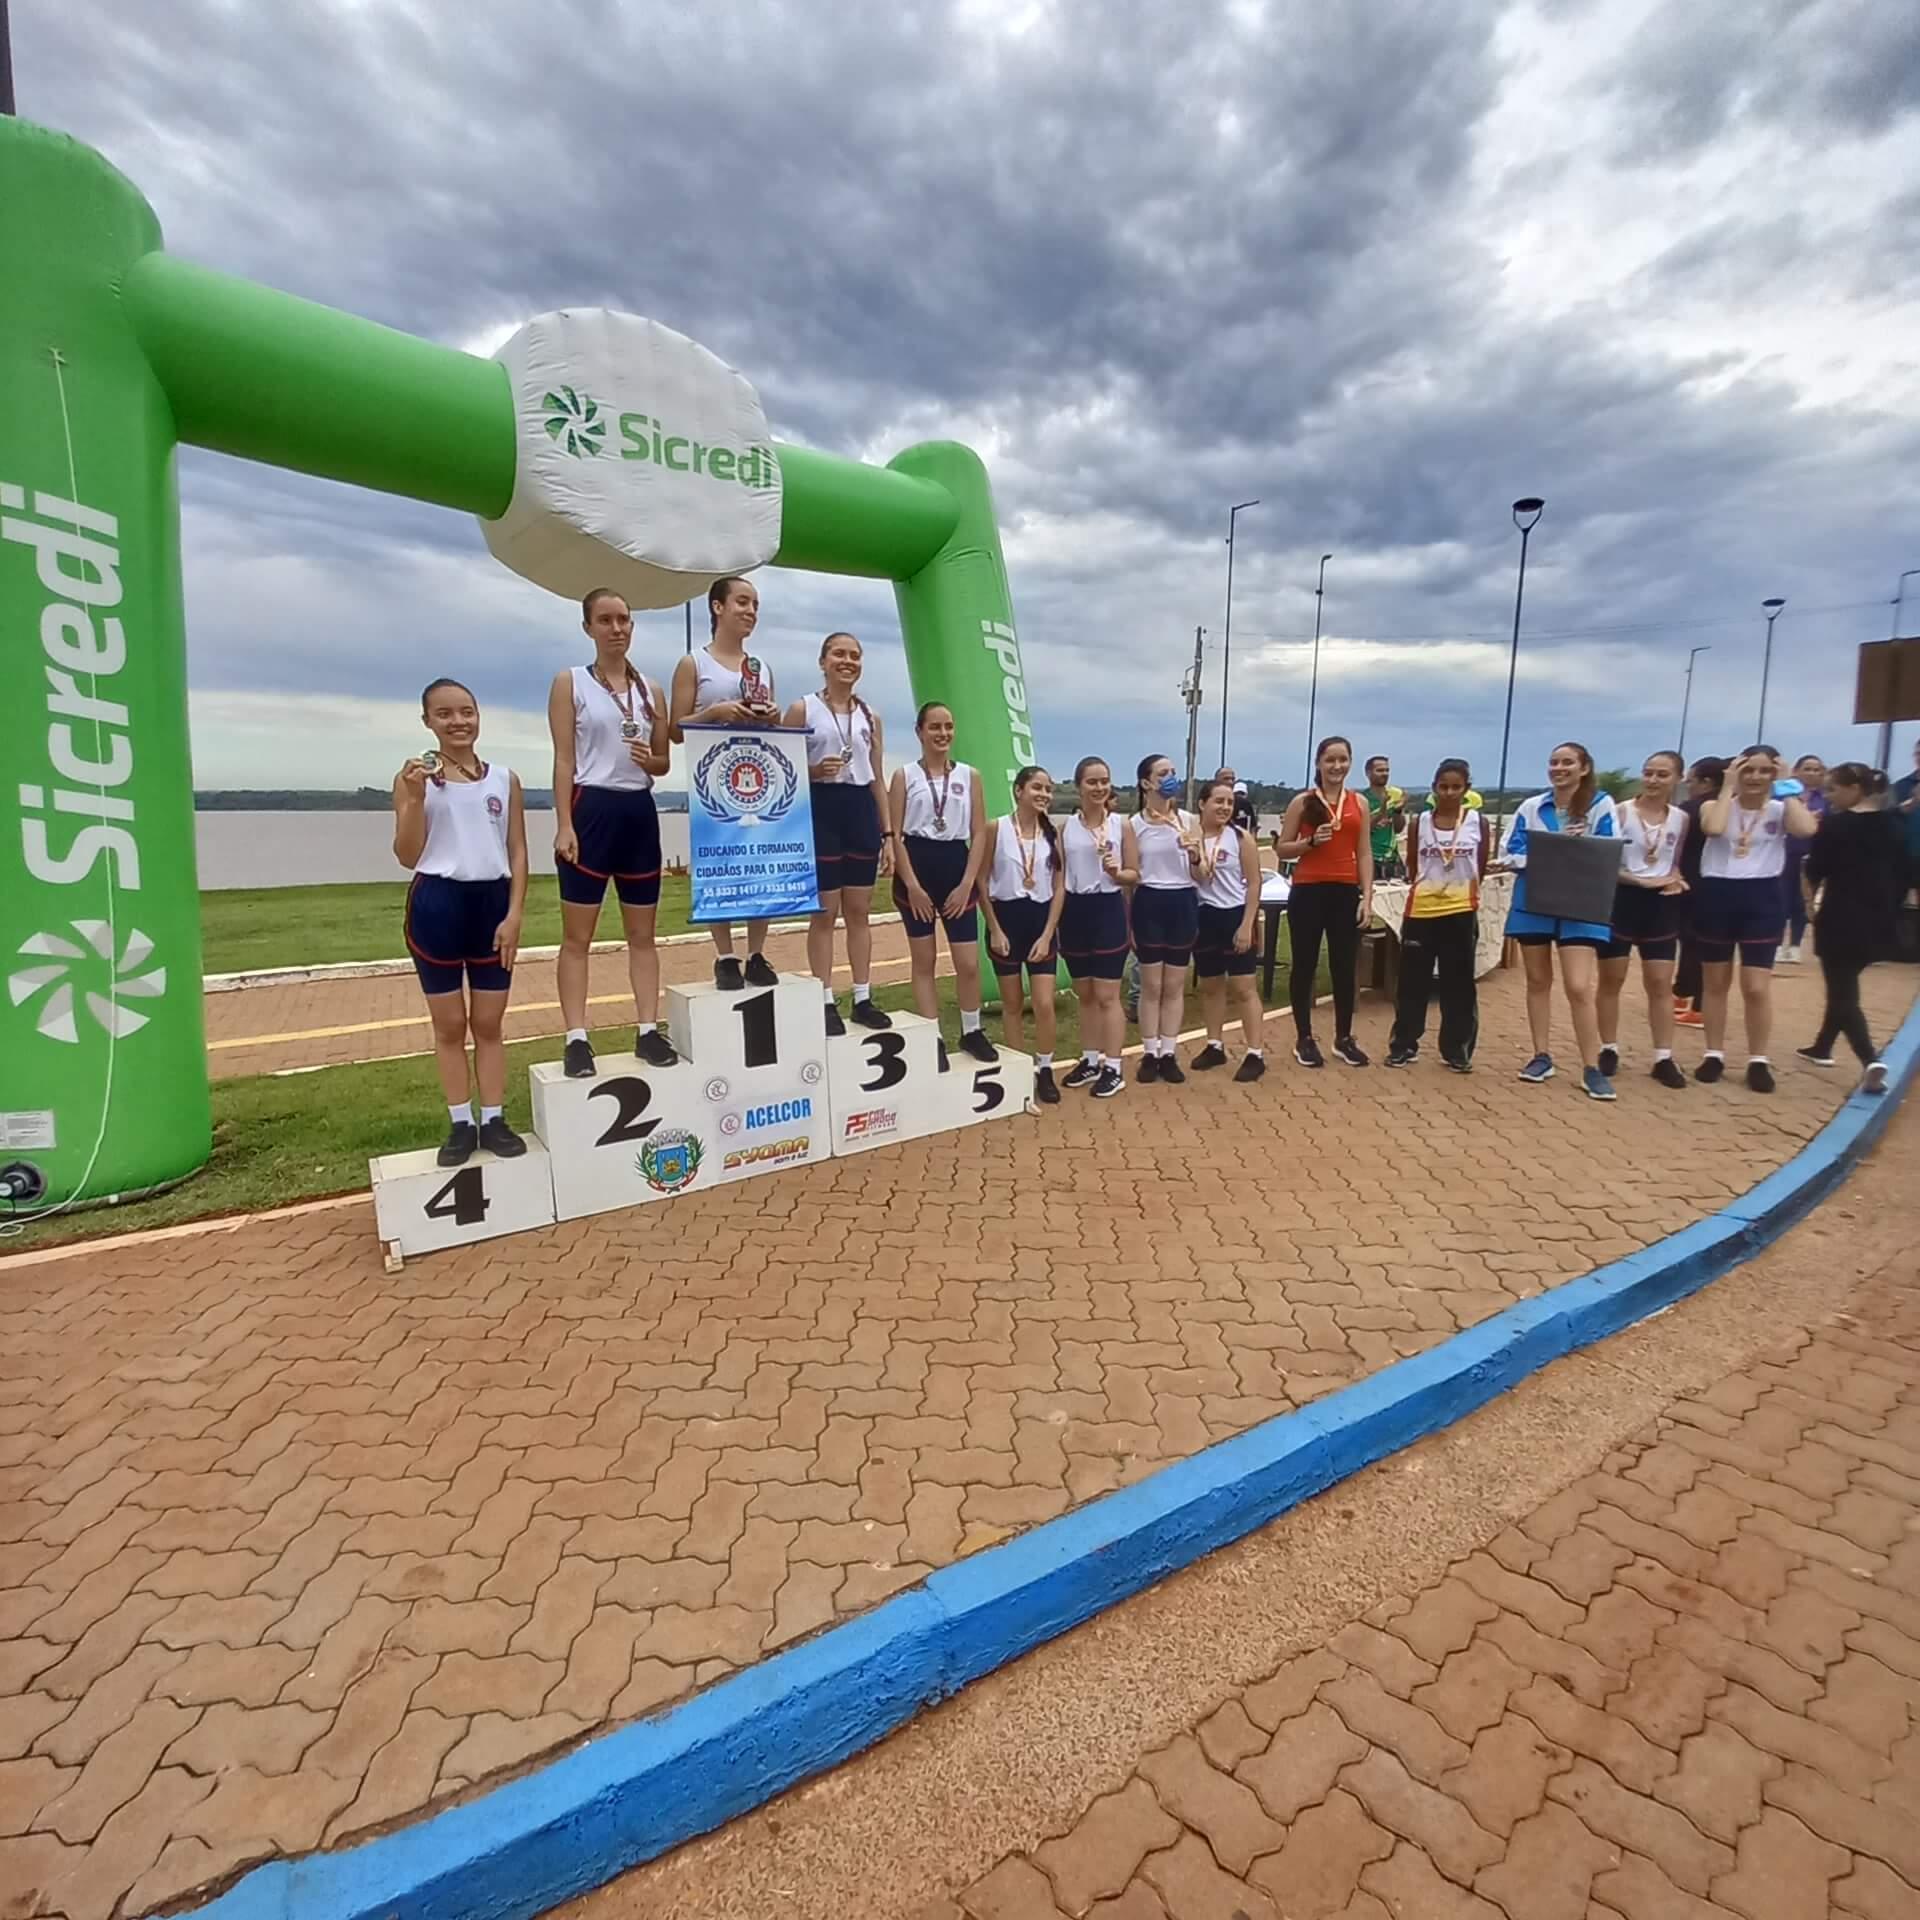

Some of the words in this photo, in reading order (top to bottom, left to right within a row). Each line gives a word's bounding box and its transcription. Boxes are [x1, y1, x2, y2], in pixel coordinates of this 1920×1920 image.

[619, 412, 772, 489] Sicredi
[0, 482, 141, 890] Sicredi
[696, 862, 742, 878] CIDADÃOS
[744, 863, 767, 875] PARA
[768, 864, 775, 874] O
[776, 861, 810, 873] MUNDO
[698, 845, 747, 857] EDUCANDO
[749, 844, 756, 855] E
[757, 842, 805, 854] FORMANDO
[732, 989, 778, 1067] 1
[859, 1032, 908, 1092] 3
[972, 1066, 1005, 1113] 5
[587, 1076, 663, 1147] 2
[745, 1098, 812, 1130] ACELCOR
[423, 1167, 491, 1226] 4
